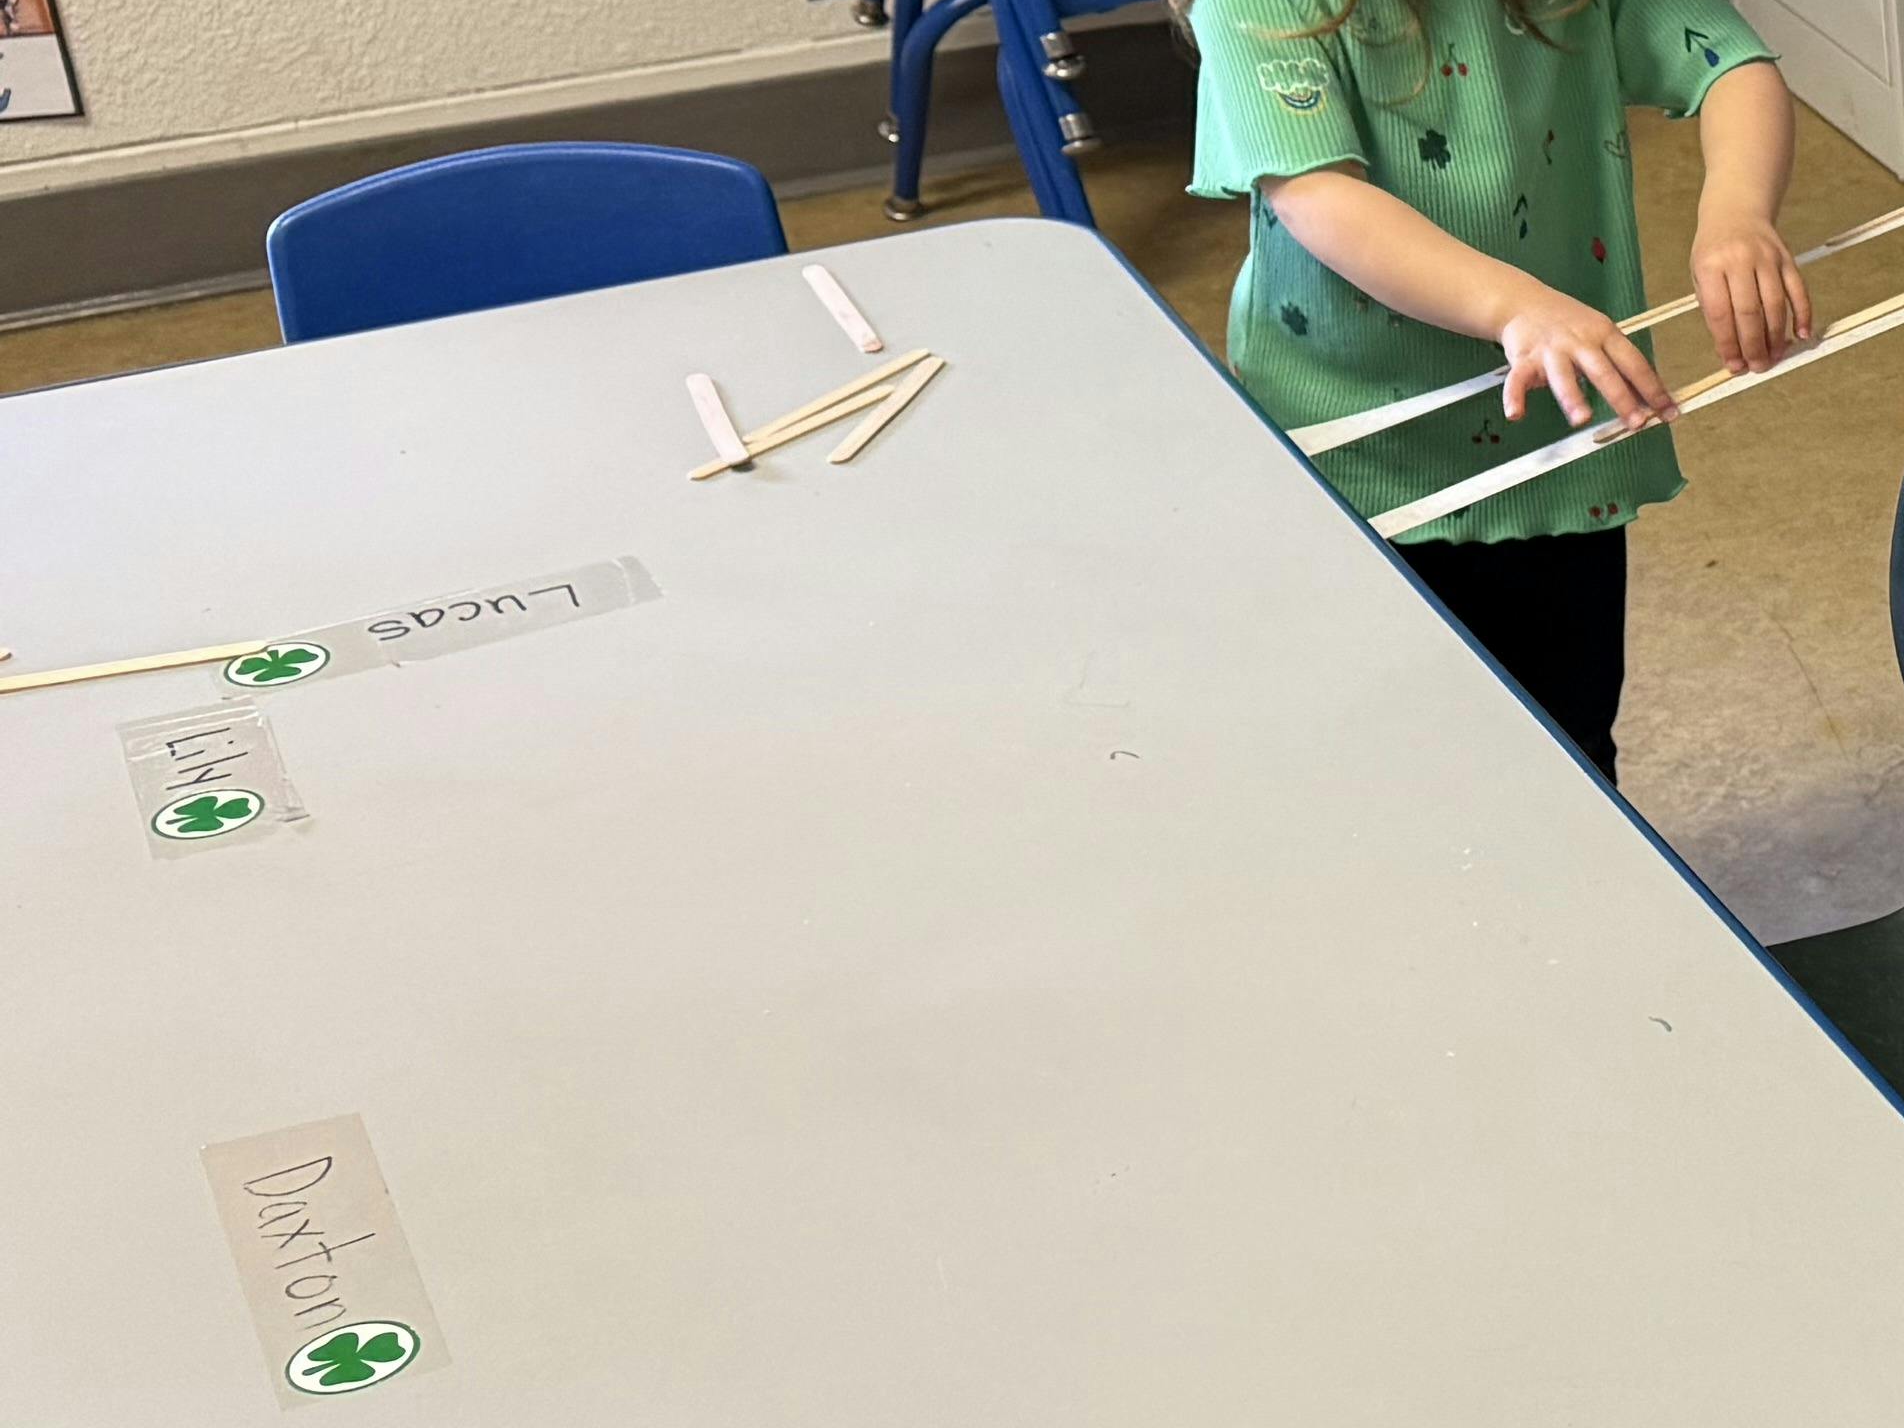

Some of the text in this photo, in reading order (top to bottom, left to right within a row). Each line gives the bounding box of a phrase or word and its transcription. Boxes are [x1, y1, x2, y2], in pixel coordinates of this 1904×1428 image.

[368, 584, 580, 642] Lucas
[166, 727, 249, 791] Lily
[243, 1156, 376, 1330] Daxton
